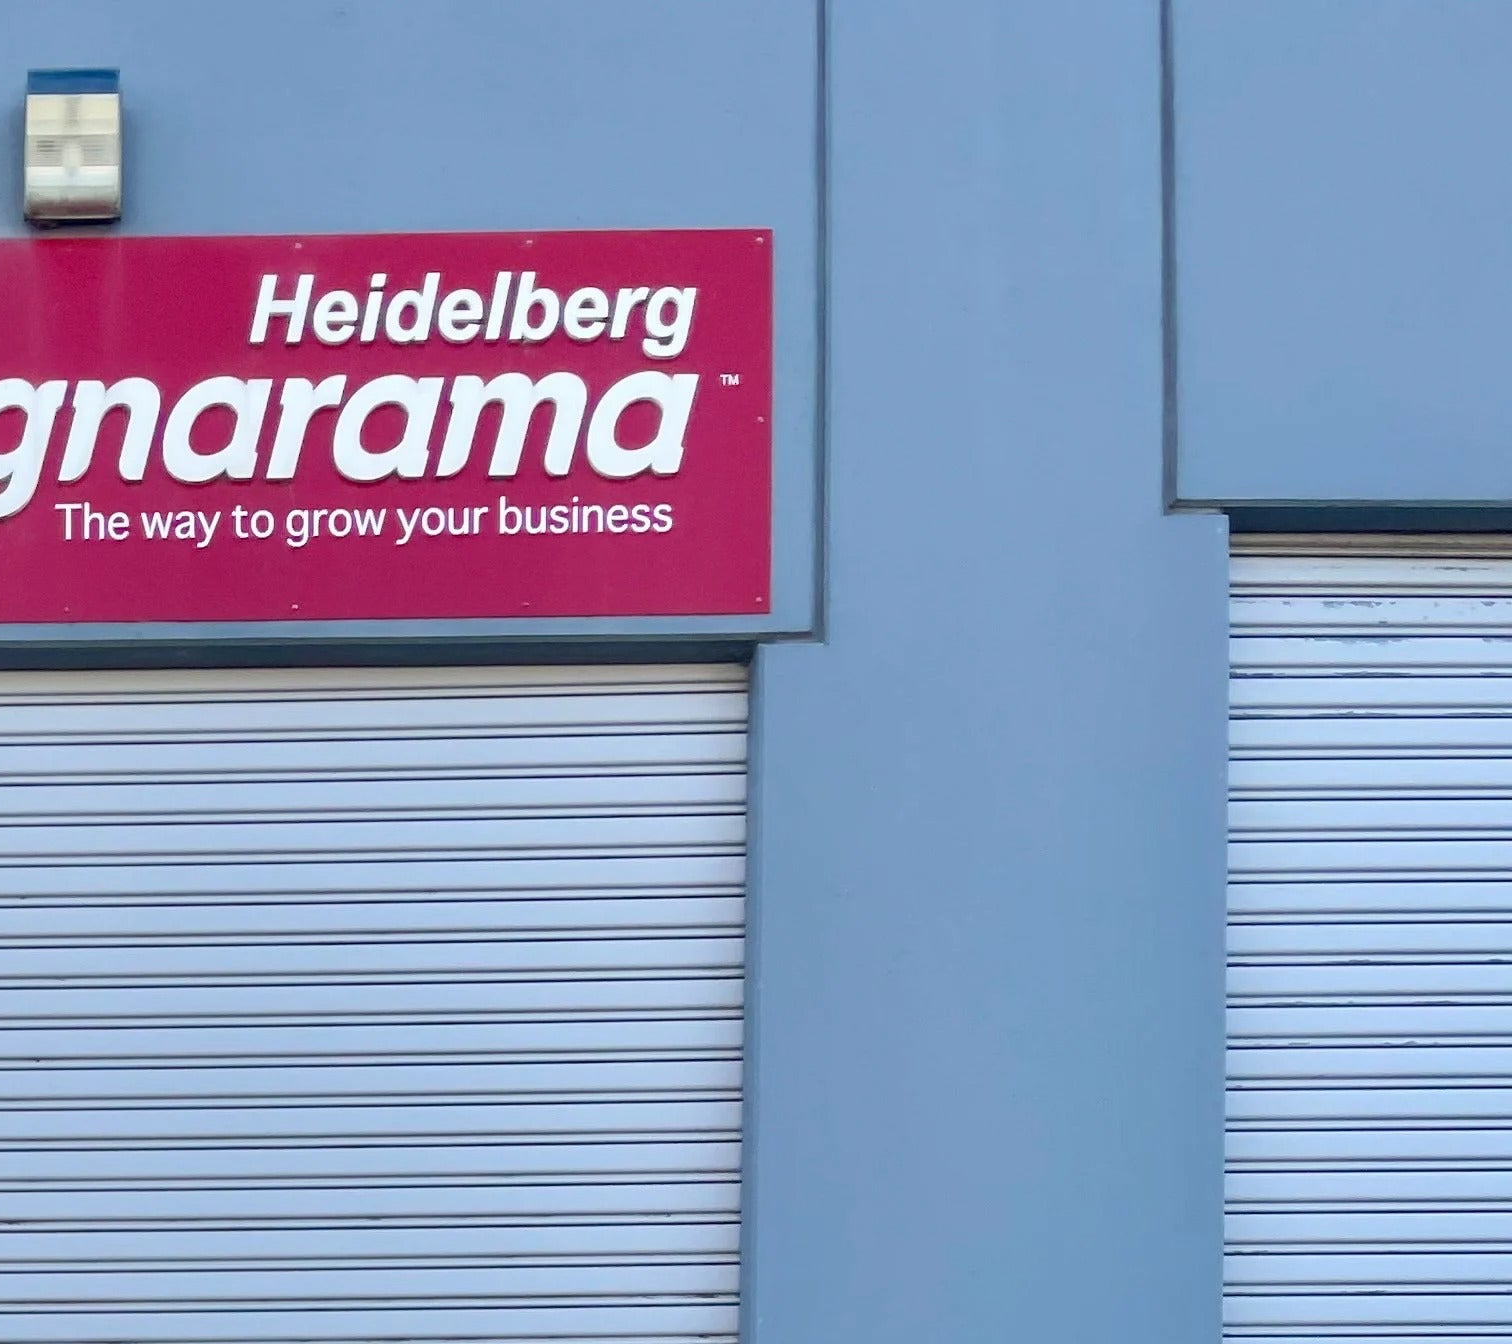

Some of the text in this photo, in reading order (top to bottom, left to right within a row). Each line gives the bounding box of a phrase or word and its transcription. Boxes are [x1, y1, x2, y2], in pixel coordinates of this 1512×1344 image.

[250, 271, 697, 357] Heidelberg
[55, 495, 673, 549] The way to grow your business
